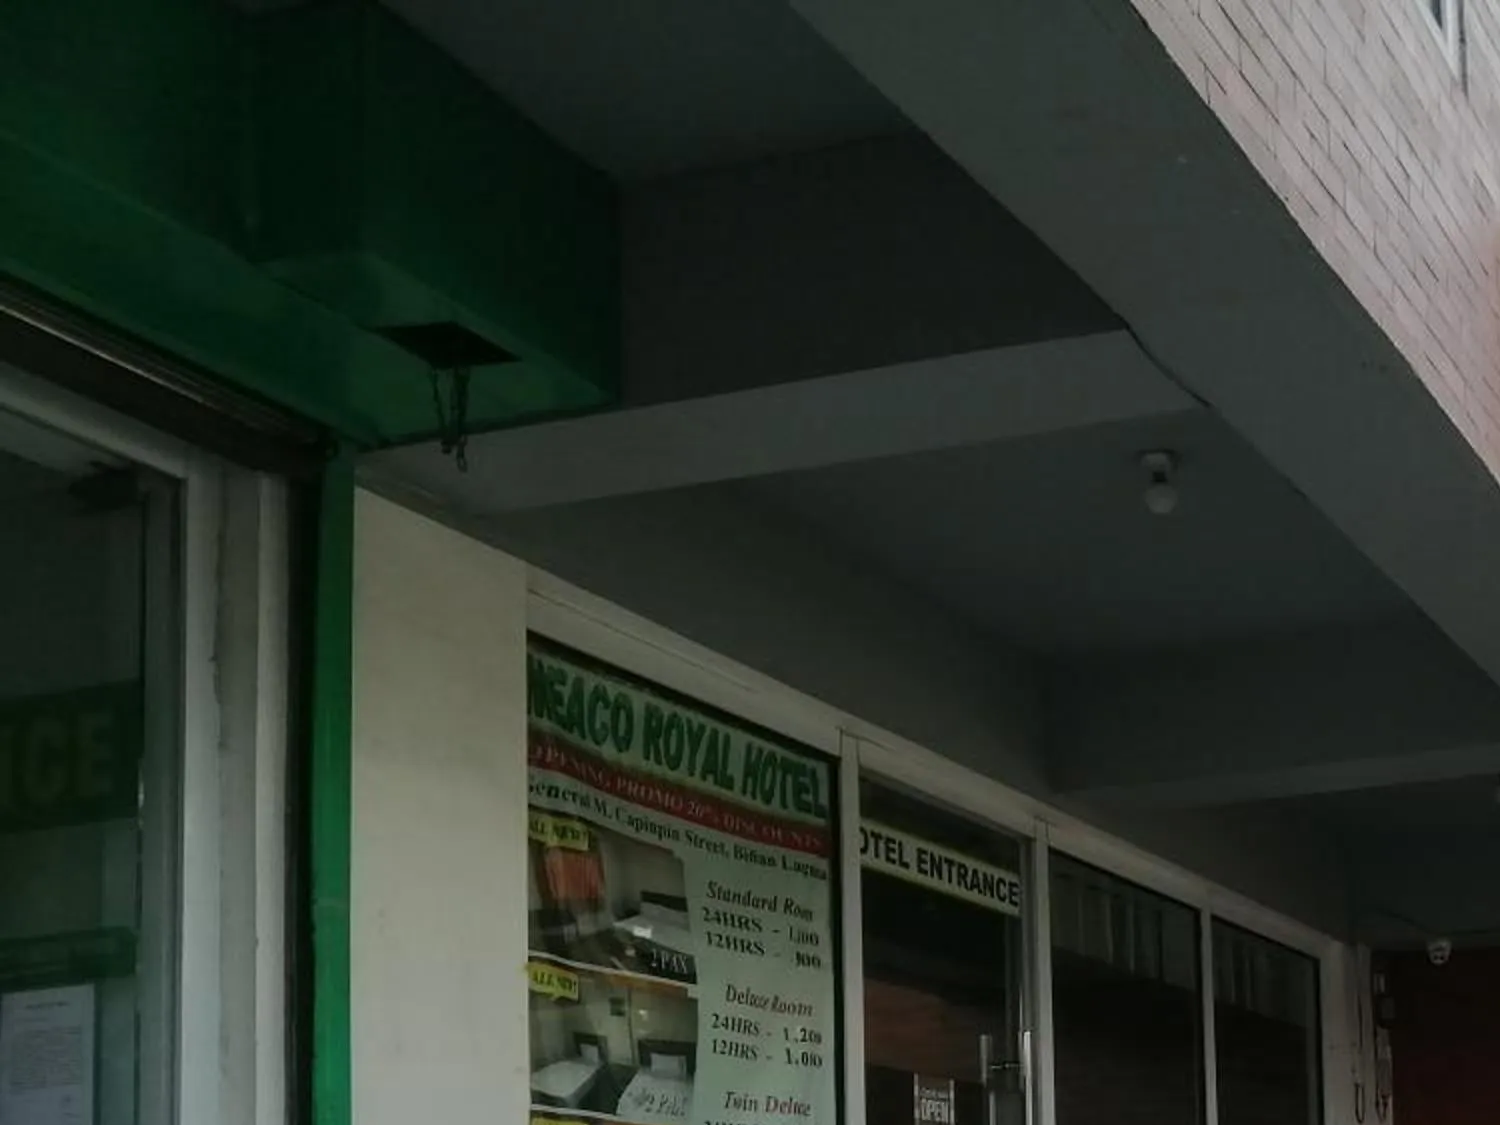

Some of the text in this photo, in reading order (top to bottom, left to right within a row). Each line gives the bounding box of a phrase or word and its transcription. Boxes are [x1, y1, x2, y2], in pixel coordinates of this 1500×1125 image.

[643, 702, 734, 791] ROYAL
[742, 739, 827, 819] HOTEL
[617, 777, 683, 809] PROMO
[917, 847, 1019, 907] ENTRANCE
[706, 881, 777, 912] Standard
[701, 907, 763, 933] 24HRS
[705, 931, 765, 957] 12HRS
[711, 1013, 760, 1036] 24HRS
[711, 1038, 758, 1062] 12HRS
[921, 1098, 950, 1124] OPEN
